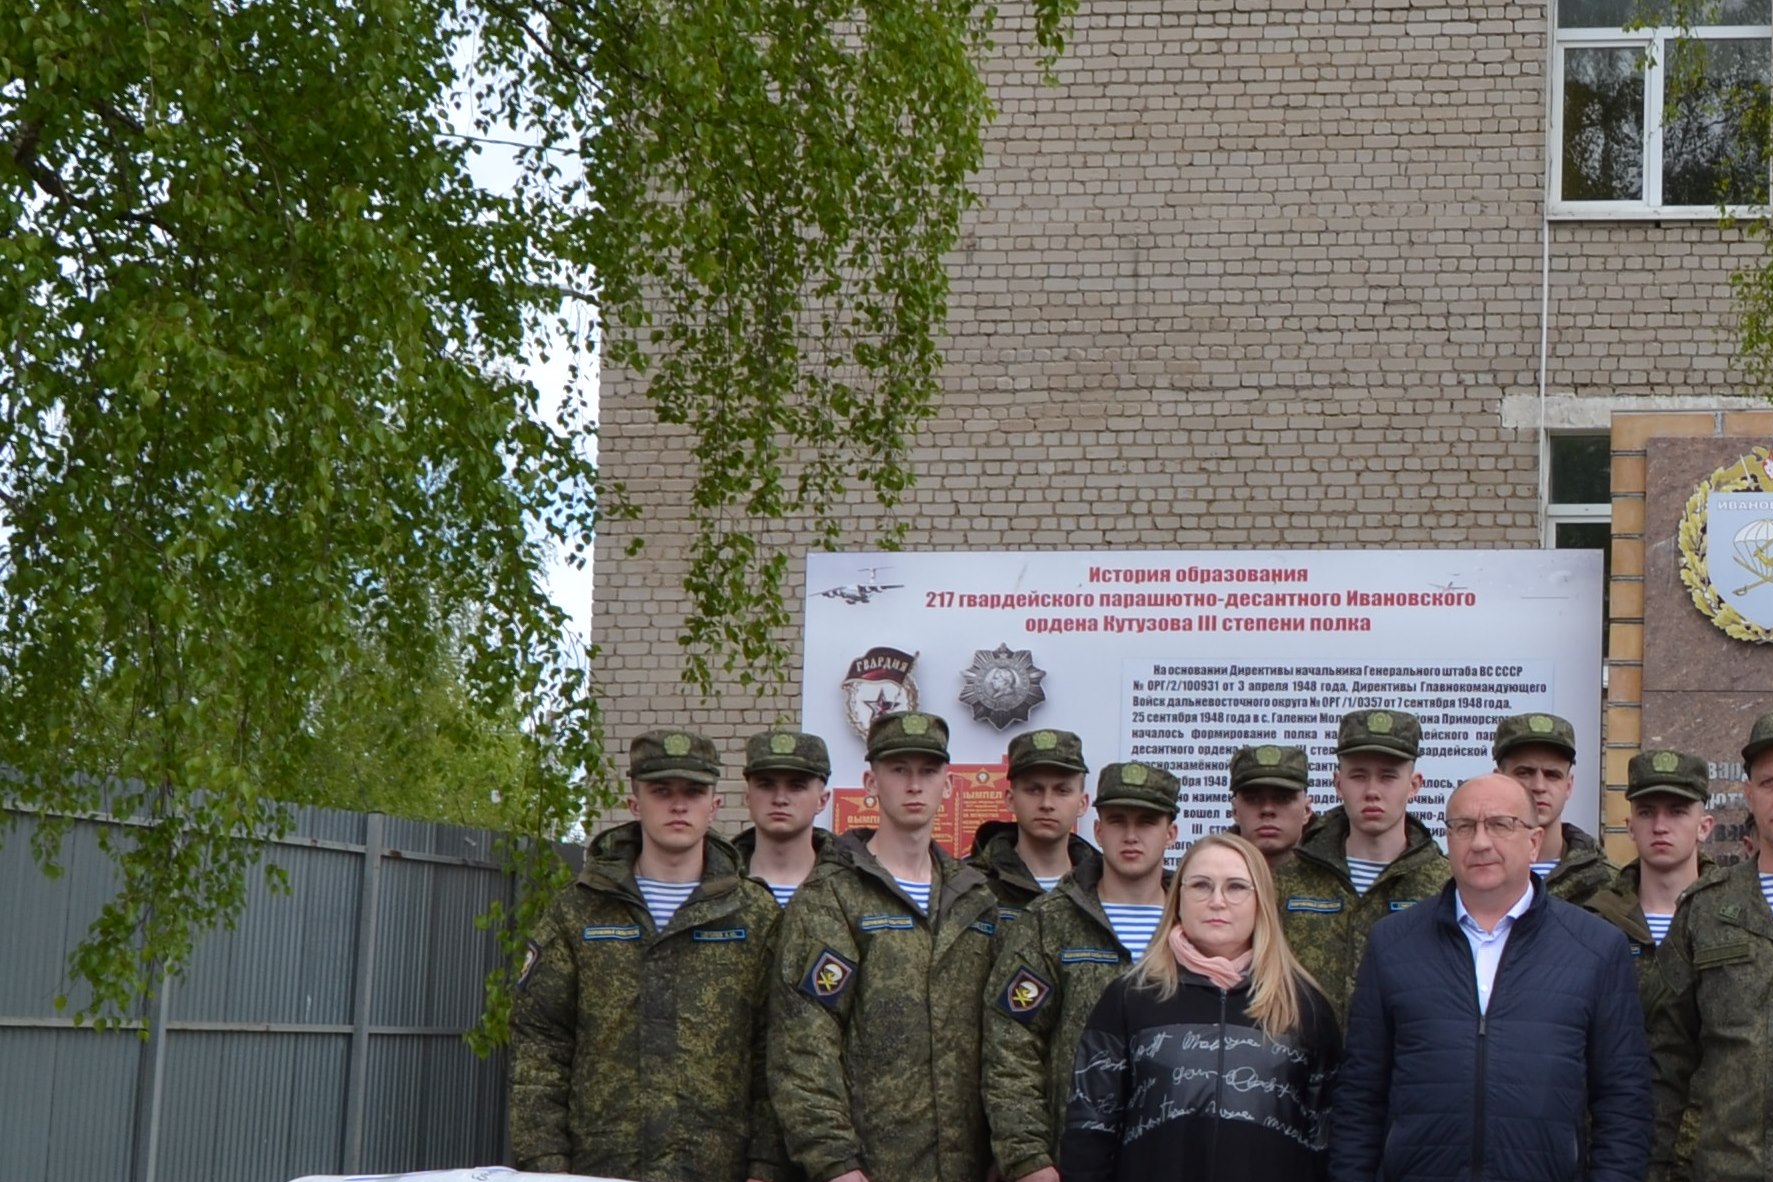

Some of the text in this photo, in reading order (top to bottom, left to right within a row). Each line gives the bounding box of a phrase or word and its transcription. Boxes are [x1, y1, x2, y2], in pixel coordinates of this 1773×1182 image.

[1089, 566, 1308, 585] История образования
[925, 589, 1475, 611] 217 гвардейского парашютно-десантного Ивановского
[1025, 614, 1371, 635] ордена Кутузова III степени полка
[856, 656, 909, 673] ГВАРДИЯ
[1153, 665, 1523, 679] На основании Директивы начальника Генерального штаба ВС СССР
[1132, 680, 1547, 695] № ОРГ/2/100931 от 3 апреля 1948 года, Директивы Главнокомандующего
[1132, 696, 1166, 707] Войск
[1166, 698, 1271, 709] дальневосточного
[1272, 697, 1308, 710] округа
[1309, 697, 1320, 707] №
[1322, 696, 1341, 707] ОРГ
[1384, 699, 1396, 708] от
[1396, 698, 1403, 708] 7
[1403, 697, 1456, 710] сентября
[1457, 698, 1483, 709] 1948
[1131, 712, 1146, 723] 25
[1146, 712, 1199, 725] сентября
[1200, 712, 1225, 723] 1948
[1226, 714, 1252, 725] года
[1253, 714, 1260, 723] в
[1261, 714, 1270, 723] с.
[1271, 713, 1318, 723] Галенки
[1131, 730, 1184, 740] началось
[1190, 729, 1277, 742] формирование
[1283, 730, 1318, 740] полка
[1130, 745, 1195, 756] десантного
[1203, 776, 1228, 787] 1948
[1183, 809, 1220, 820] вошел
